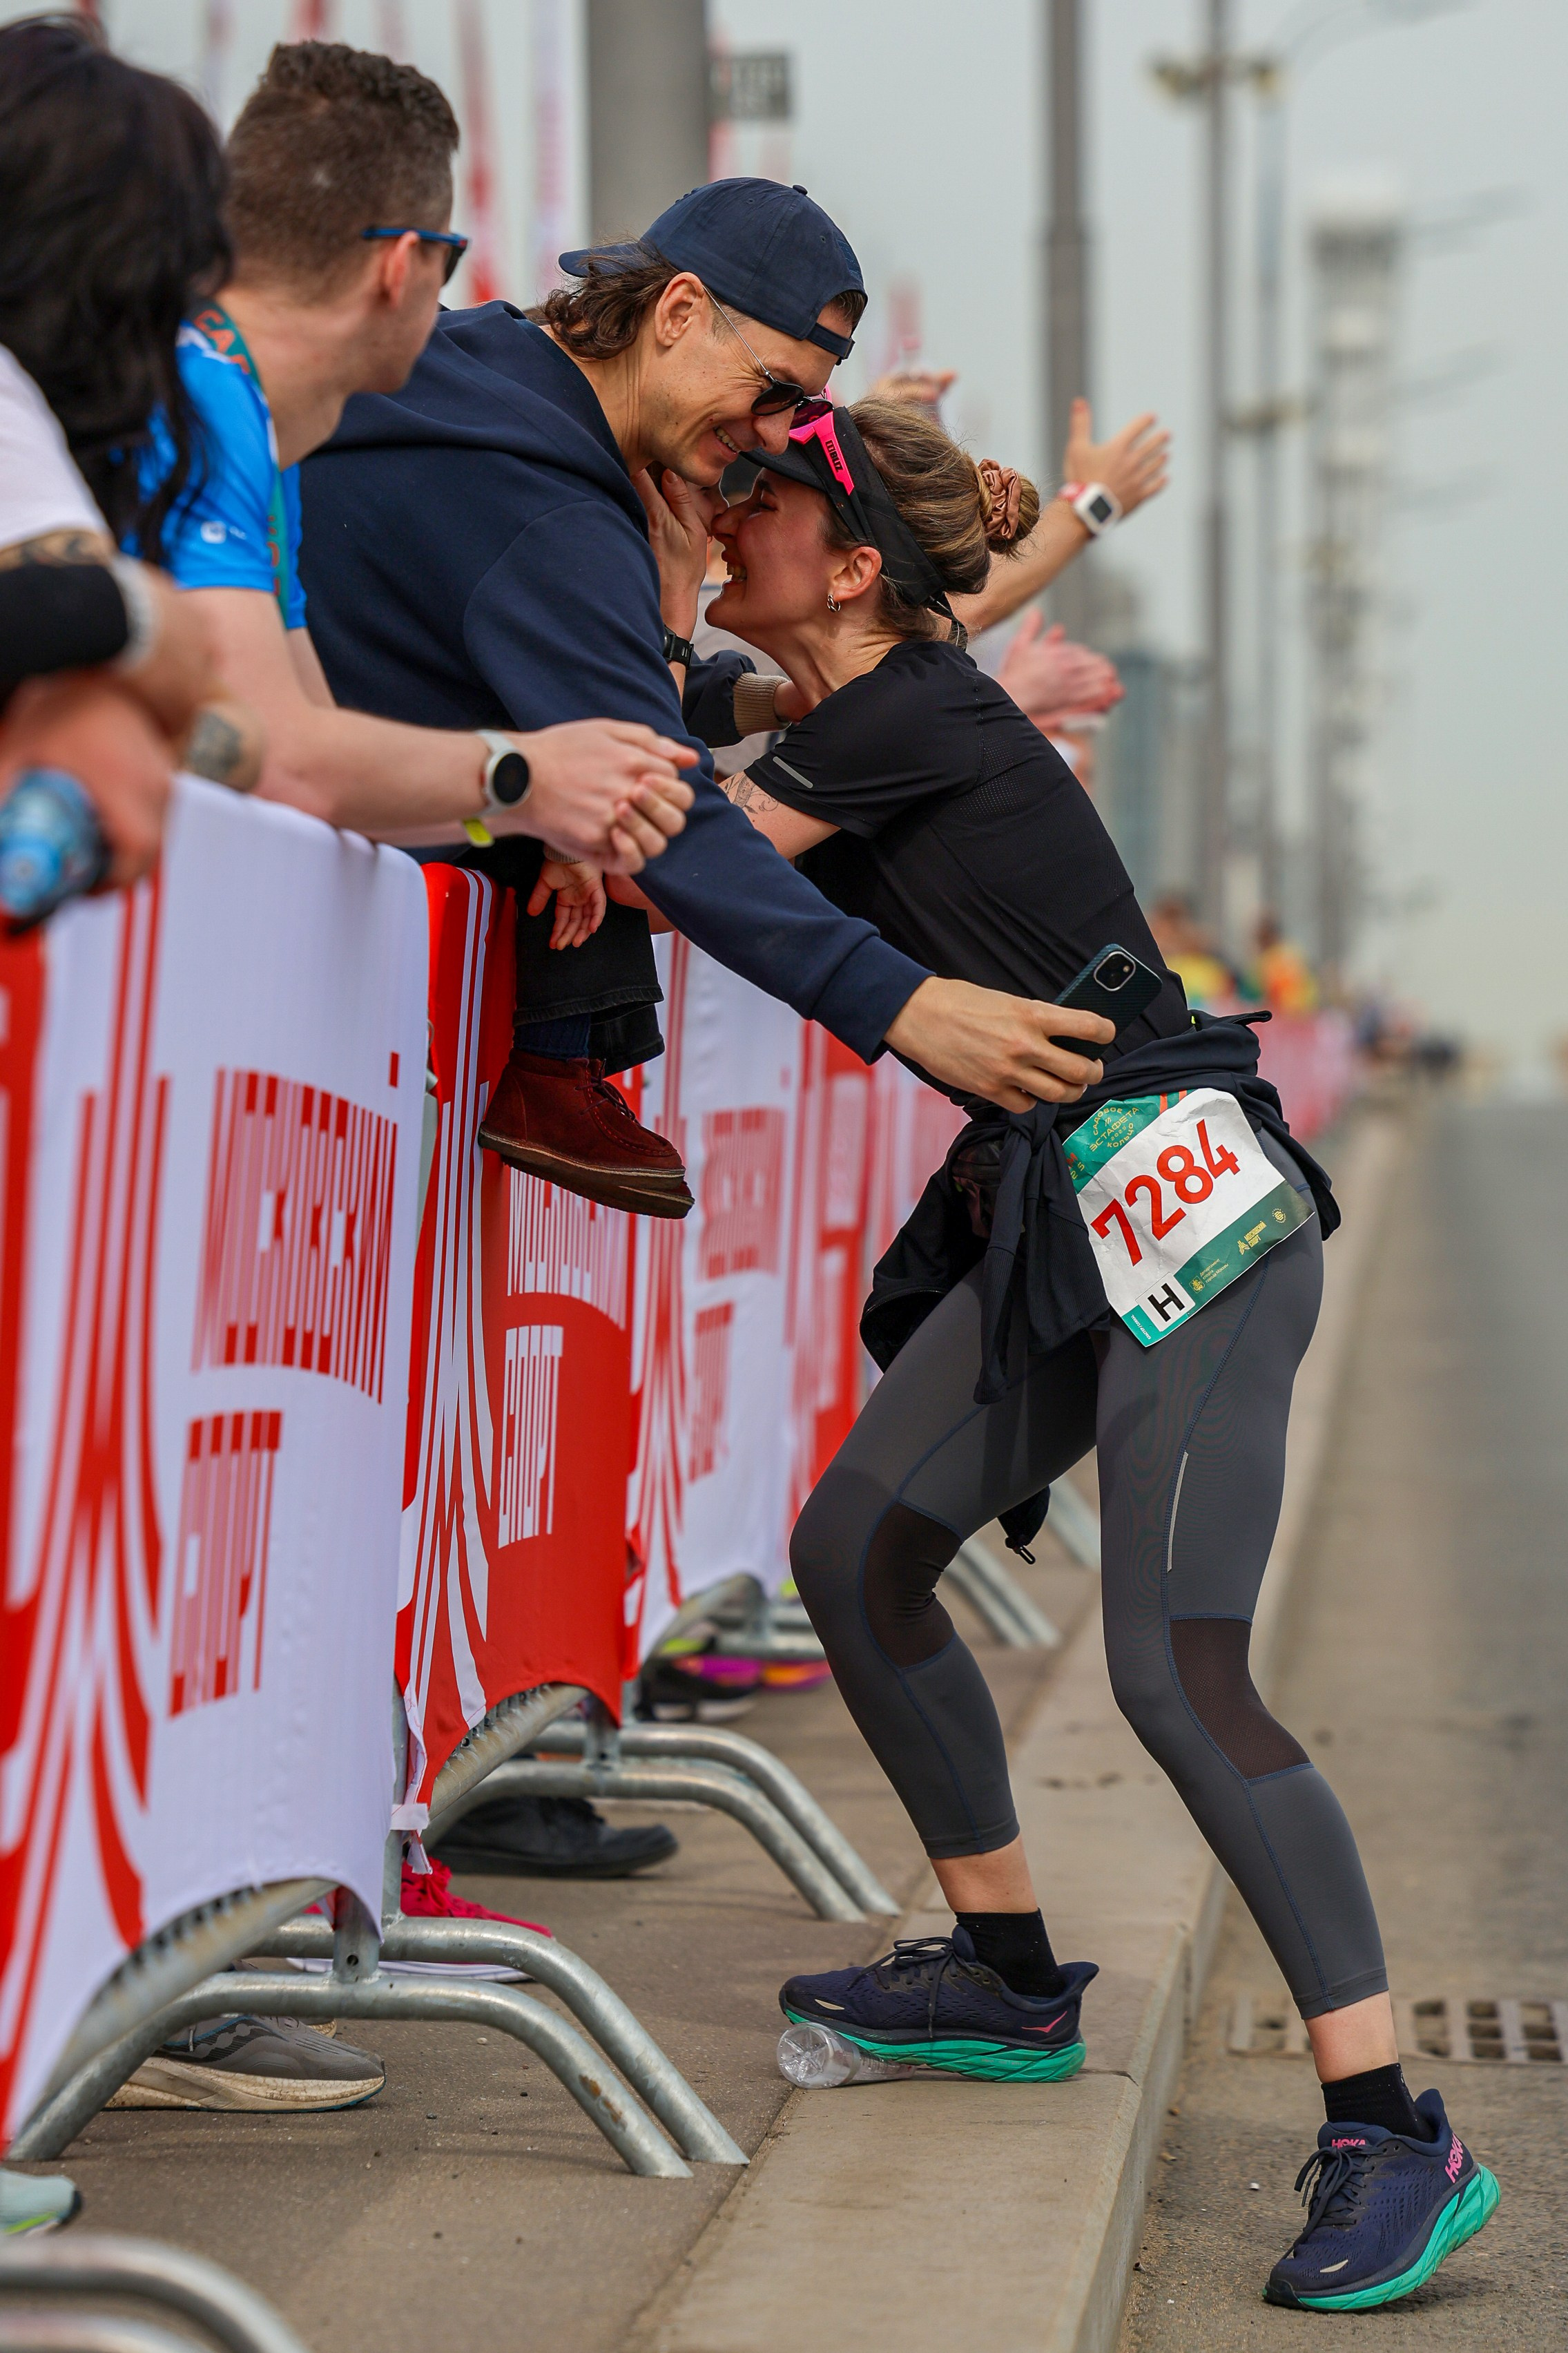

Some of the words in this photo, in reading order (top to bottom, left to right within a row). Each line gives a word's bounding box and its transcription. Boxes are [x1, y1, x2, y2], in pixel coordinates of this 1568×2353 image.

[1090, 1107, 1139, 1152] ЭСТАФЕТА
[1093, 1107, 1123, 1136] САДОВОЕ
[1111, 1126, 1127, 1141] 2025
[1090, 1119, 1241, 1267] 7284
[498, 1325, 563, 1549] СПОРТ
[1331, 2138, 1366, 2150] HOKA
[1445, 2133, 1464, 2184] HOKA
